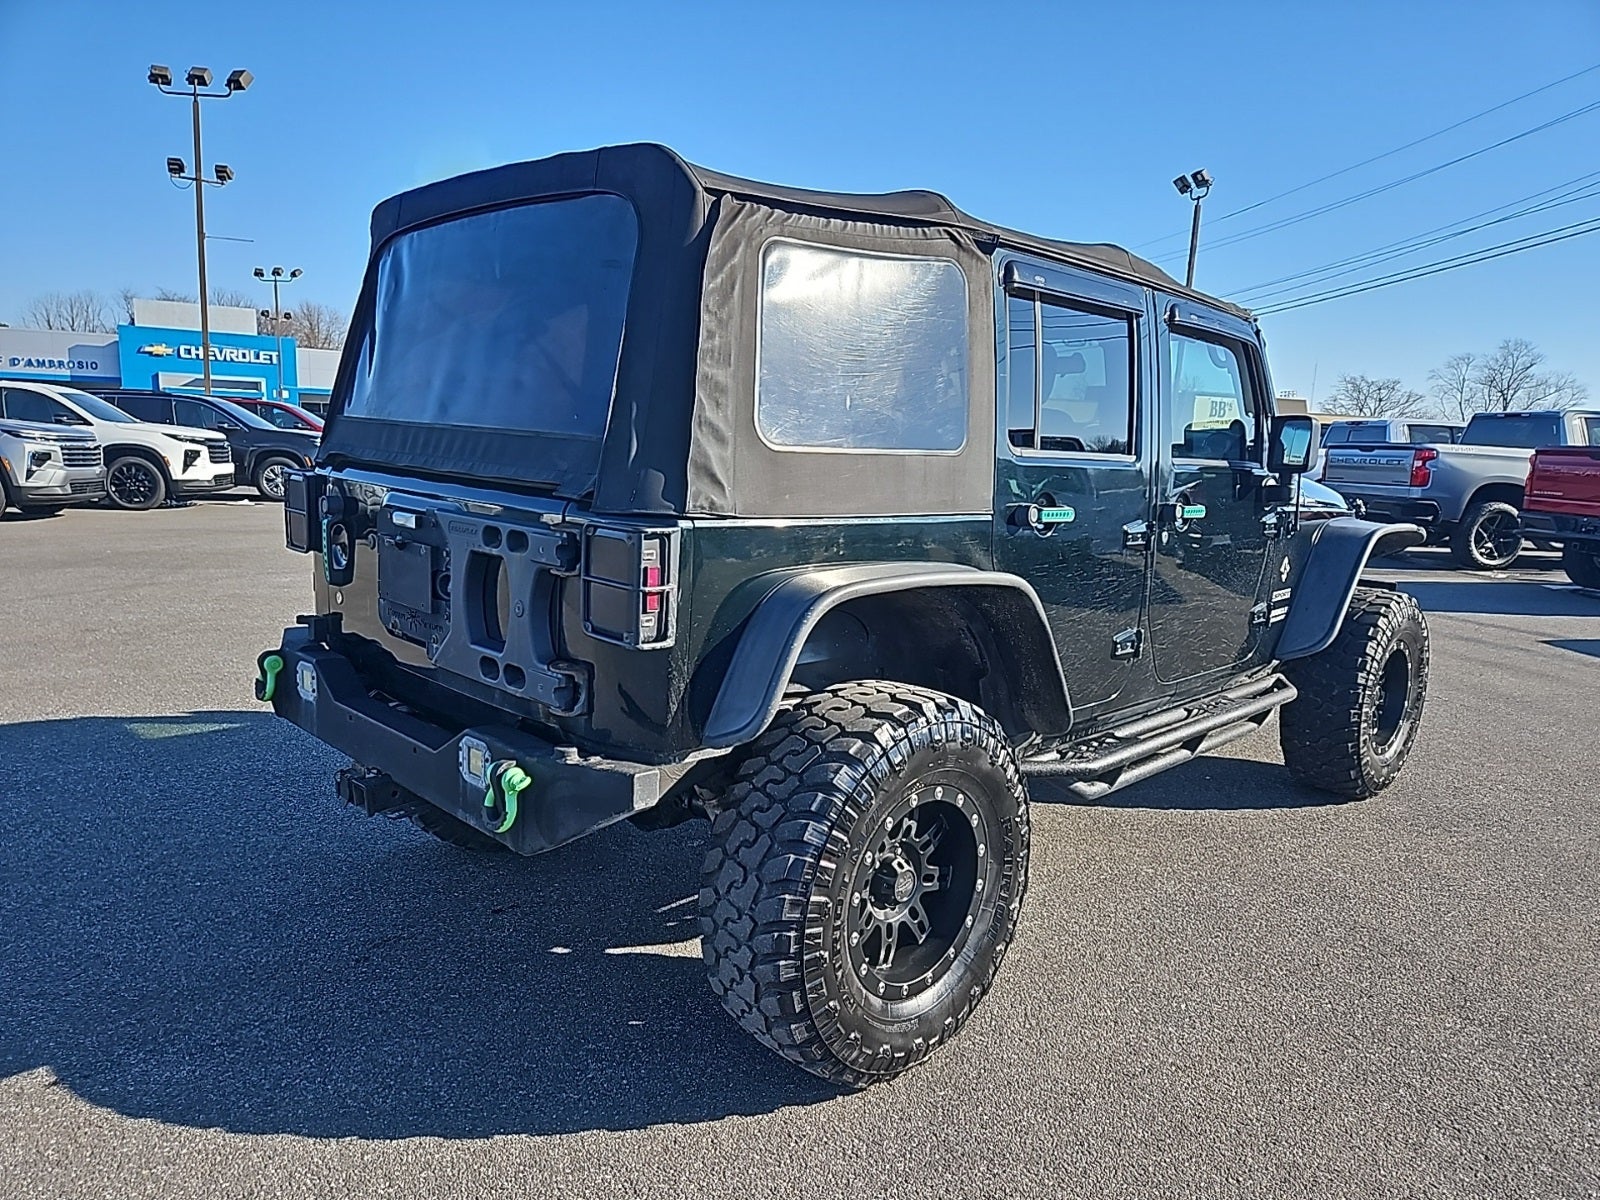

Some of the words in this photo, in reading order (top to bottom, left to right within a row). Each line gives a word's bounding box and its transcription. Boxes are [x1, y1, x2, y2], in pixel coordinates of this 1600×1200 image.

[178, 344, 279, 365] CHEVROLET
[9, 357, 98, 371] D'AMBROSIO
[1330, 457, 1405, 467] CHEVROLET
